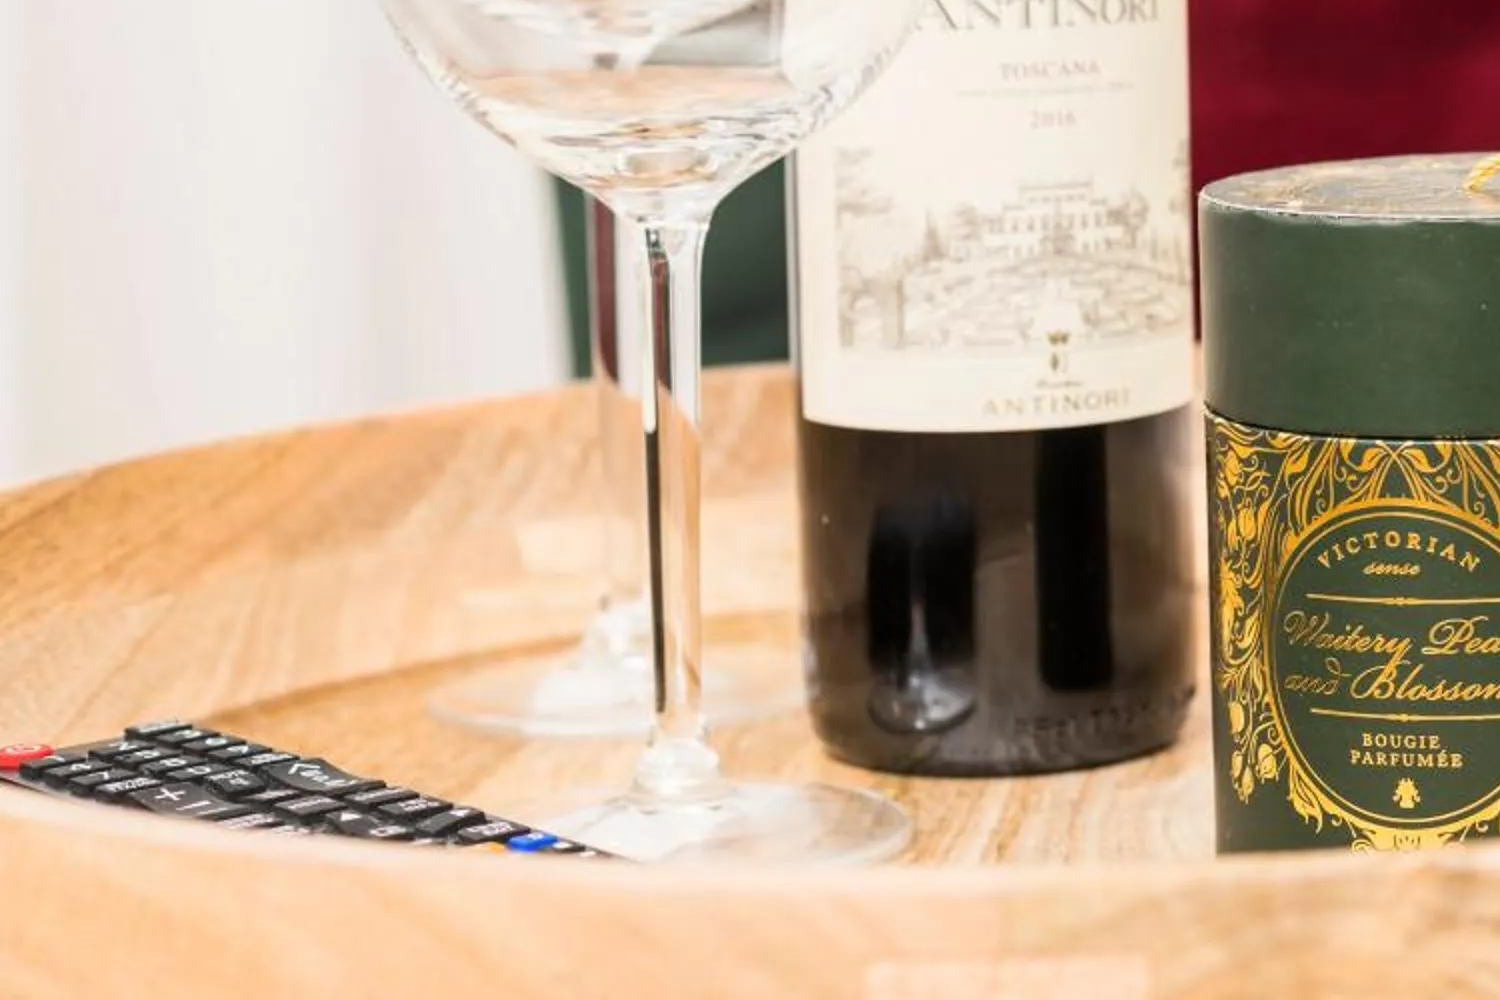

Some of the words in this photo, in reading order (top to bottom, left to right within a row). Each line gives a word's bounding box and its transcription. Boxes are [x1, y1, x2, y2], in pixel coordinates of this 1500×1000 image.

[998, 59, 1102, 82] TOSCANA
[982, 388, 1132, 416] ANTINORI
[1317, 531, 1481, 572] VICTORIAN
[1363, 561, 1421, 576] sense
[1284, 657, 1352, 695] and
[1362, 733, 1441, 749] BOUGIE
[1350, 749, 1464, 768] PARFUMÉE
